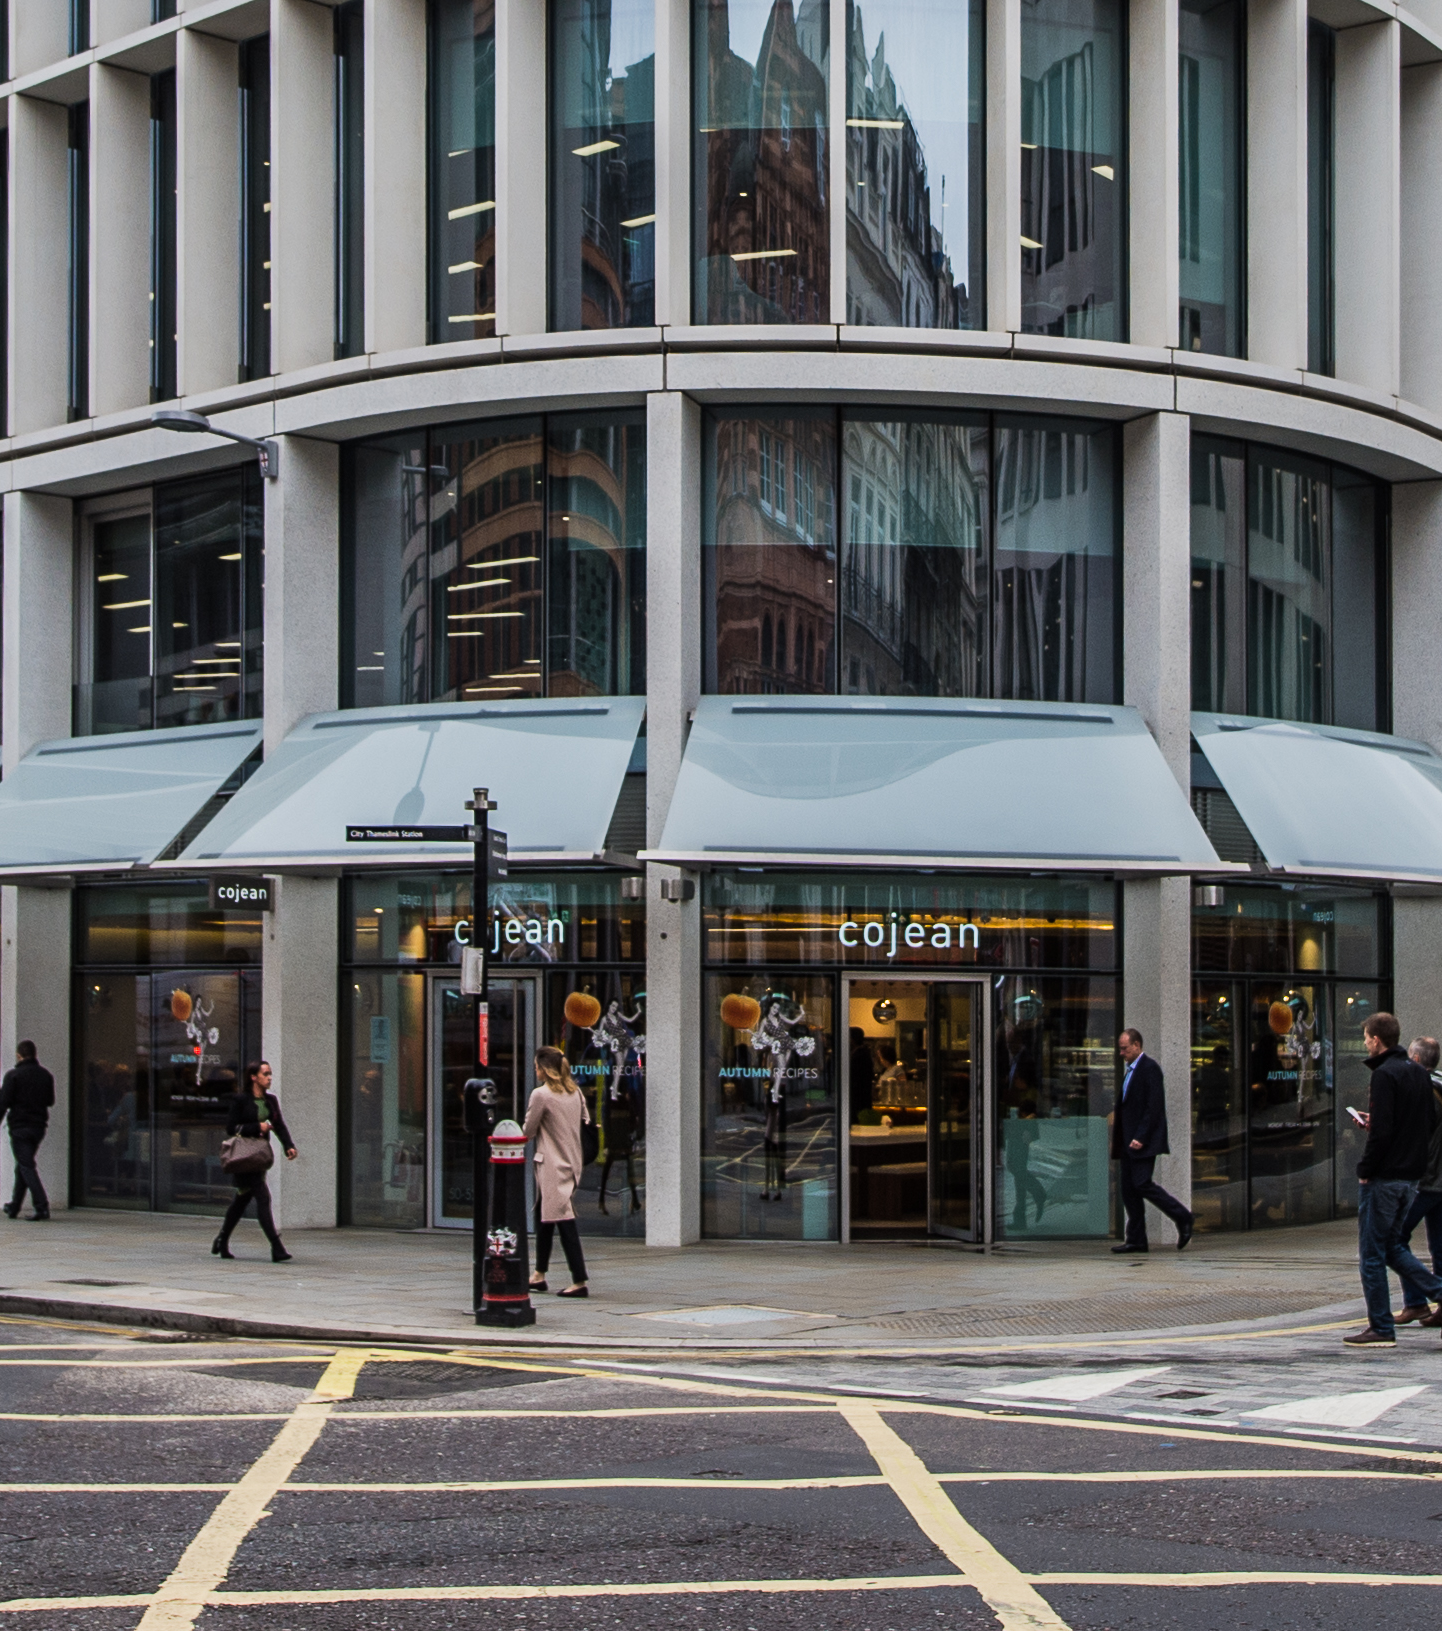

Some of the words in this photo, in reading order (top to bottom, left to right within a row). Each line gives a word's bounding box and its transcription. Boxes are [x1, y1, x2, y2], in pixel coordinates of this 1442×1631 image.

[350, 830, 364, 838] City
[366, 830, 400, 838] Thameslink
[401, 830, 423, 838] Station
[218, 883, 267, 903] cojean
[454, 910, 564, 954] cjean
[839, 912, 979, 957] cojean
[569, 1065, 610, 1075] UTUMN
[719, 1067, 771, 1078] AUTUMN
[773, 1068, 819, 1079] RECIPES
[1267, 1070, 1298, 1080] AUTUMN
[449, 1187, 475, 1202] 50-5
